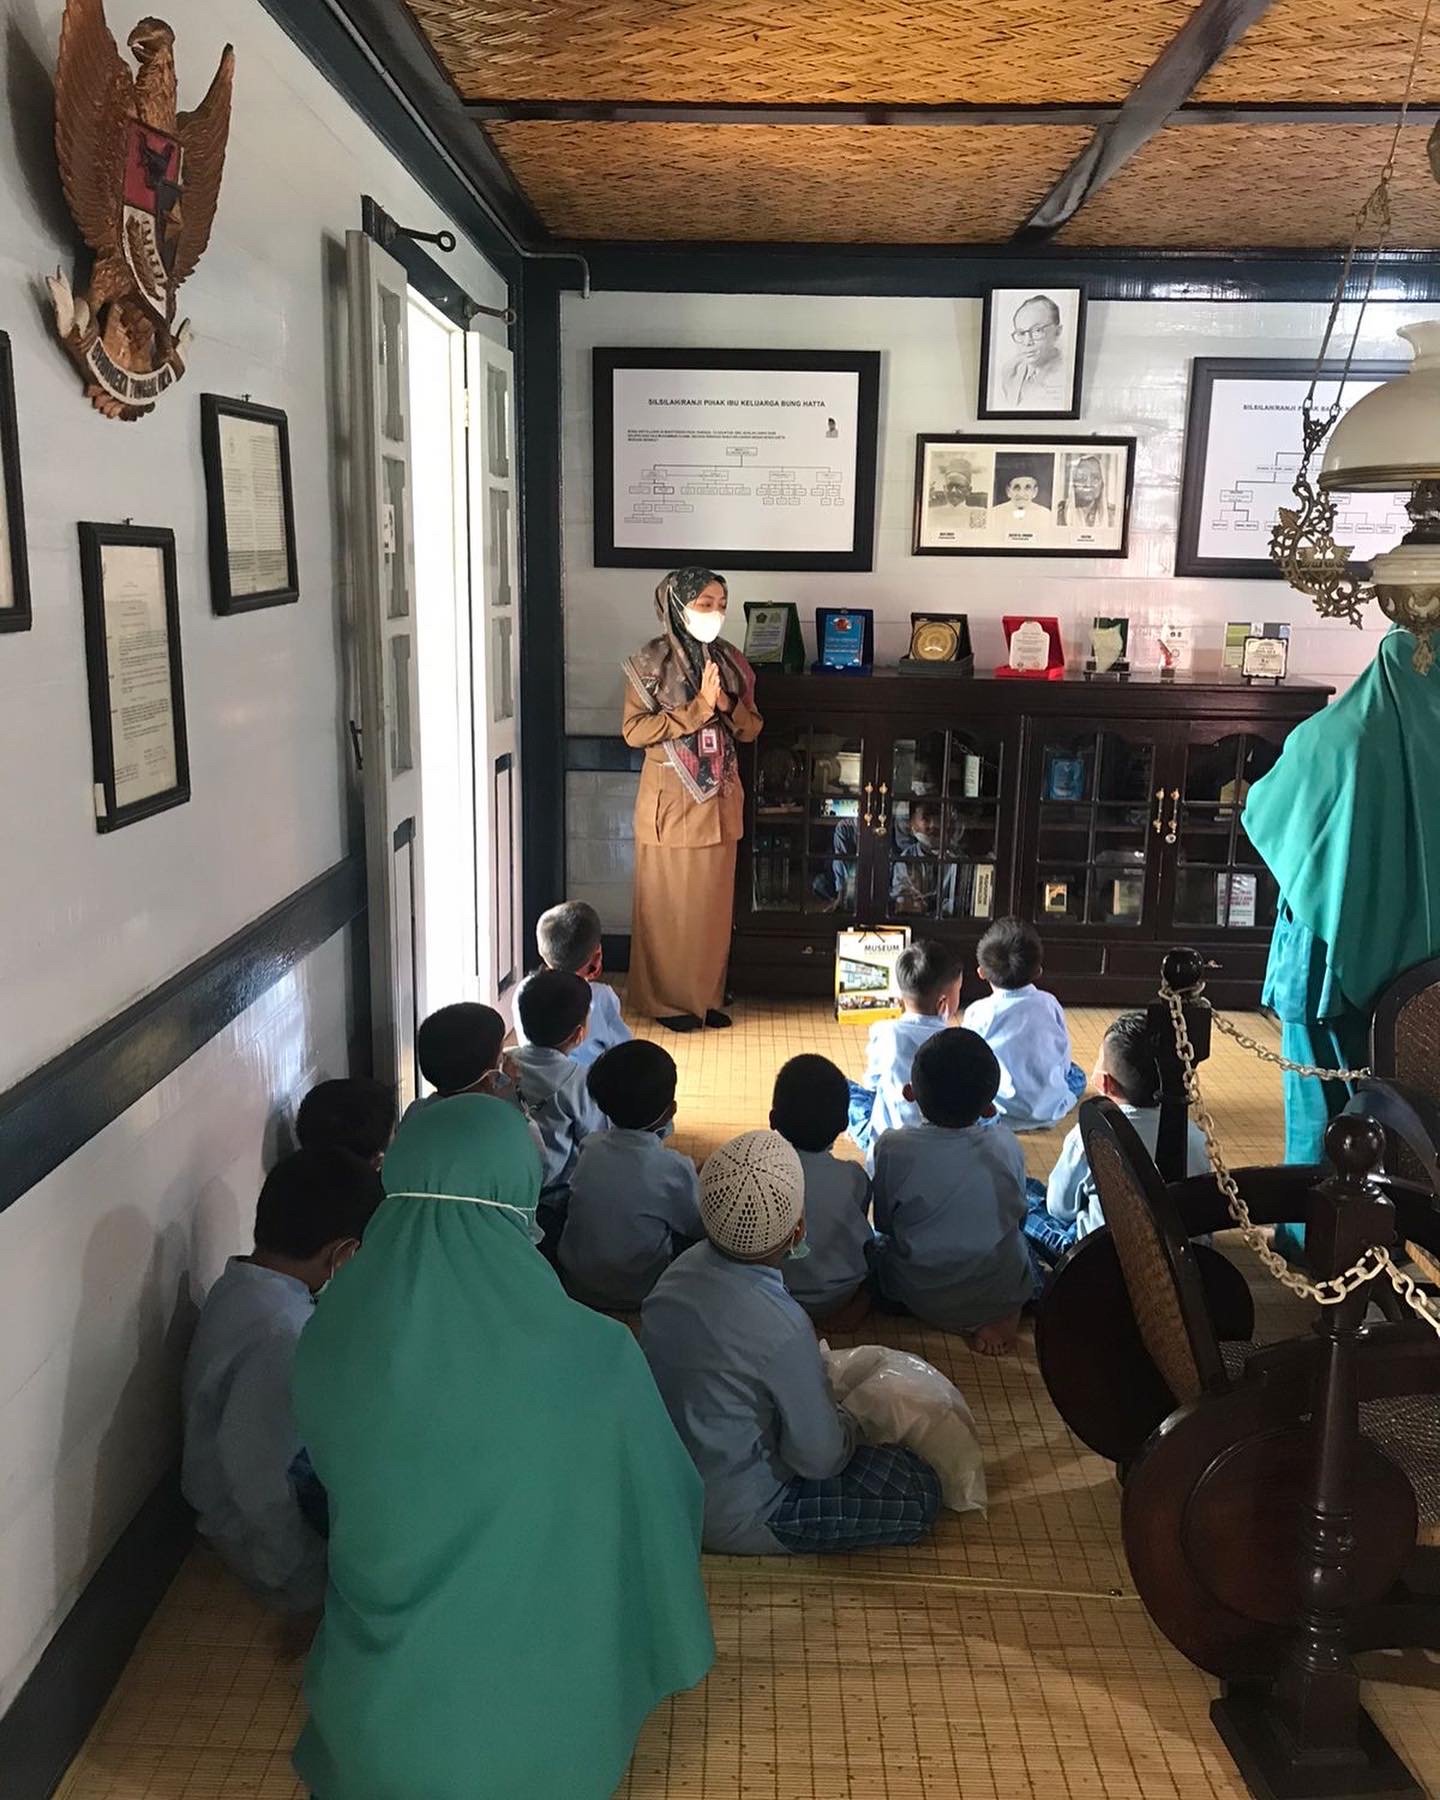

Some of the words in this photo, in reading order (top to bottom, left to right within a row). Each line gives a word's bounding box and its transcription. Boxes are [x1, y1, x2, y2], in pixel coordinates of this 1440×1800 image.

[704, 399, 725, 407] PIHAK
[727, 399, 739, 407] IBU
[864, 944, 899, 952] MUSEUM
